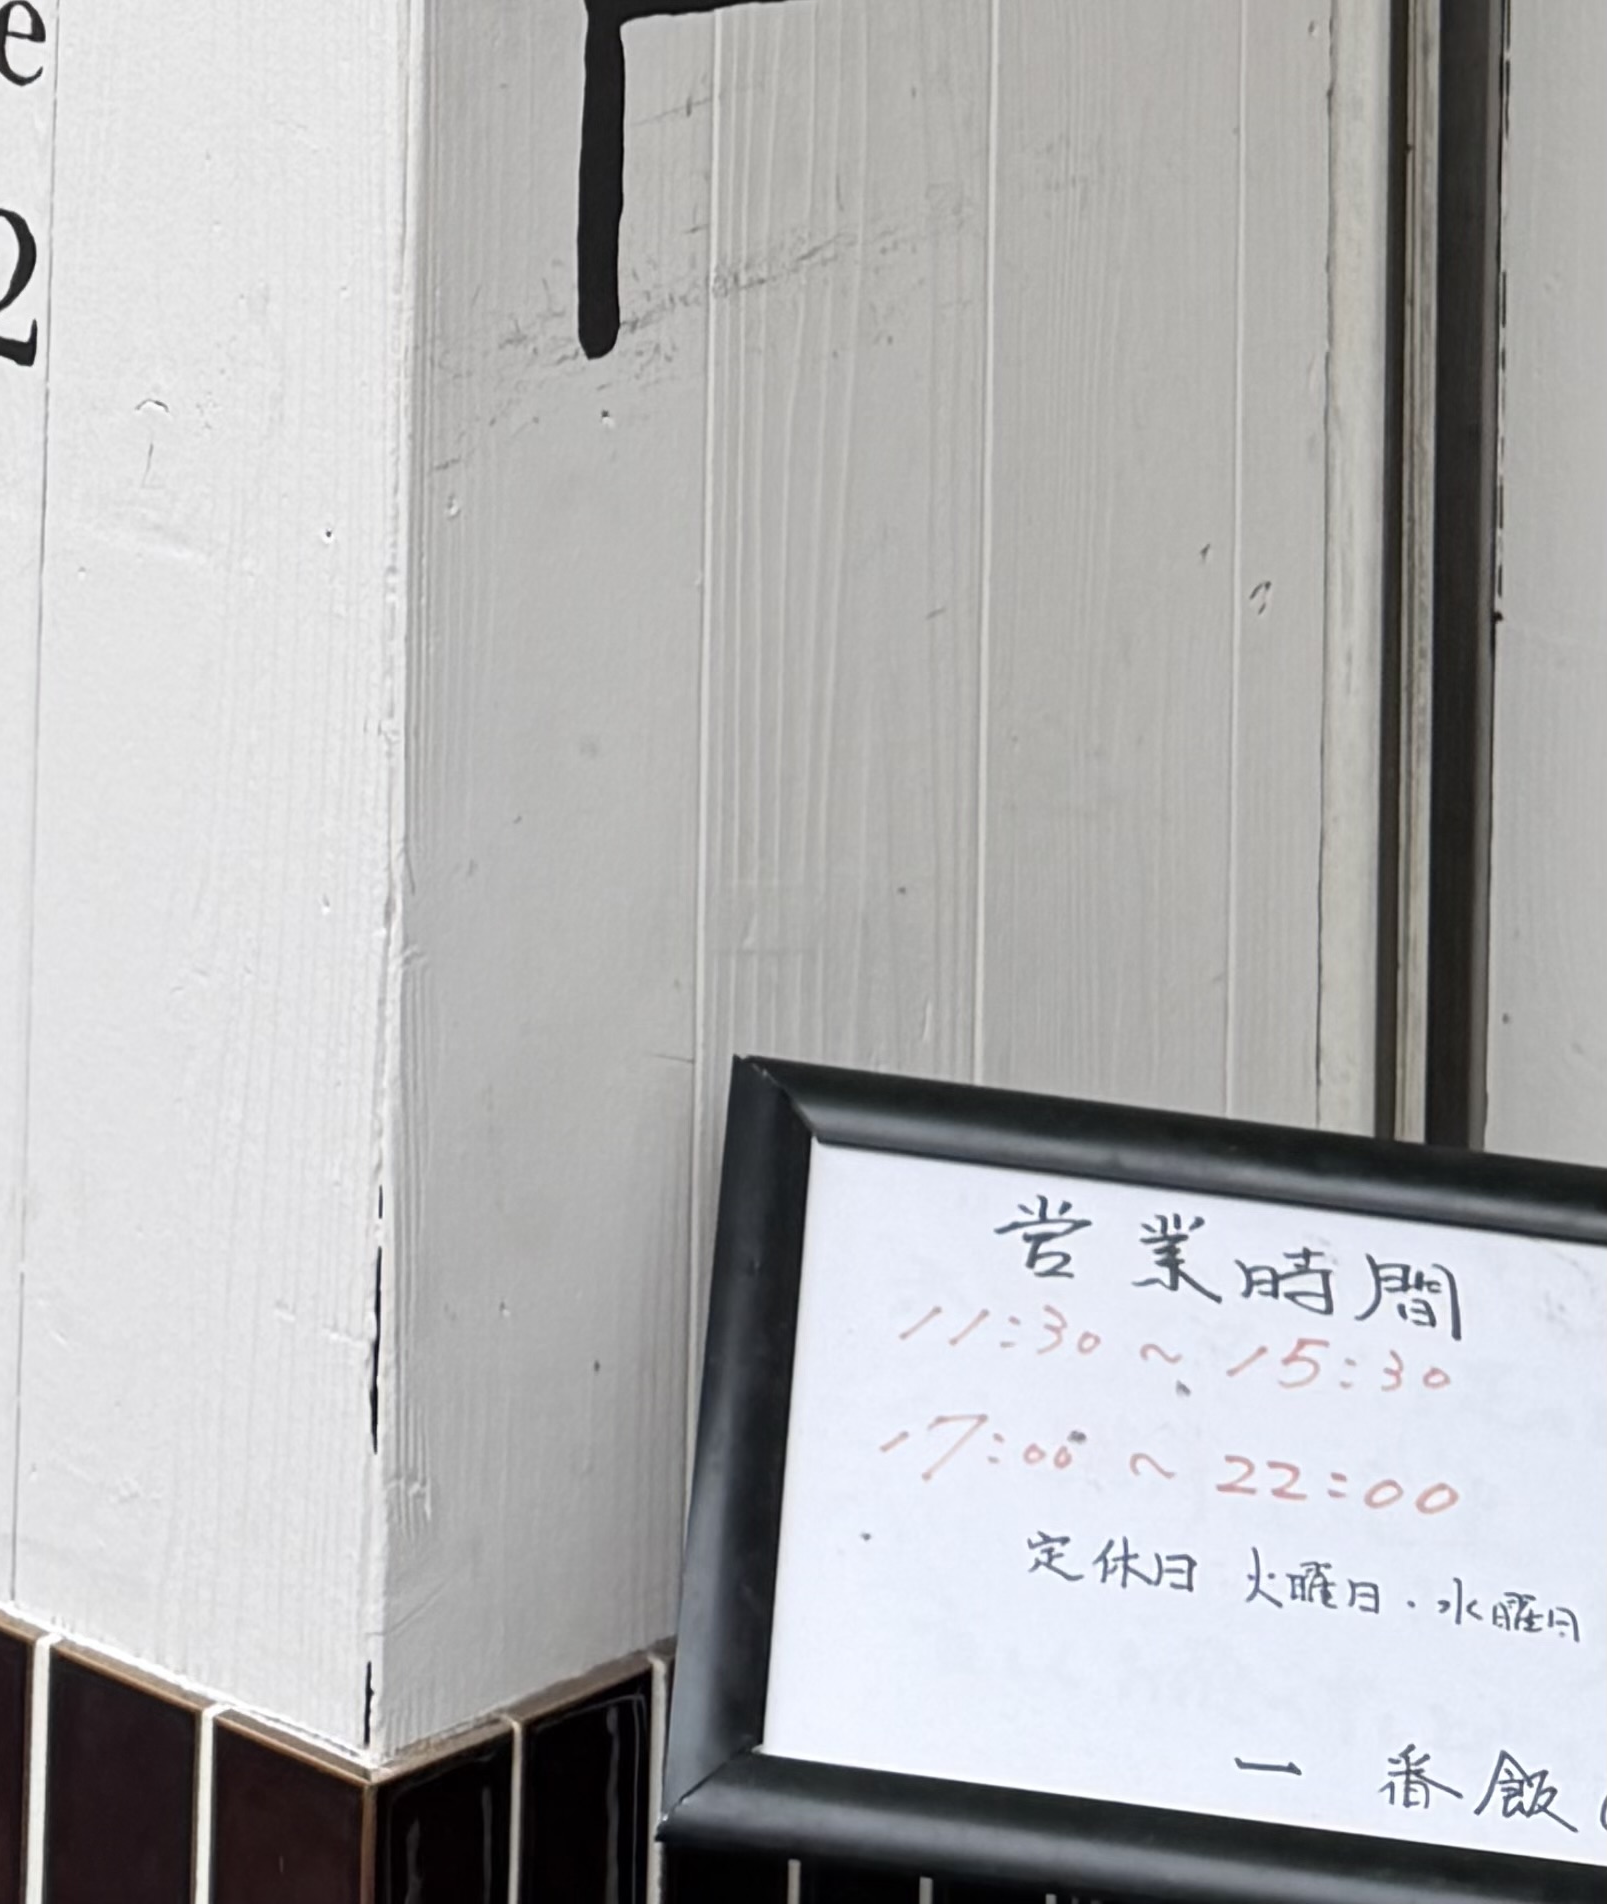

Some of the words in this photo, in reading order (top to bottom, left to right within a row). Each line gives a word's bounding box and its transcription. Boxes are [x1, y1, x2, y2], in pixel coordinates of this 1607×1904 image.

[994, 1194, 1462, 1341] 営業時間
[1026, 1530, 1198, 1593] 定休日
[1233, 1743, 1607, 1834] 一番飯
